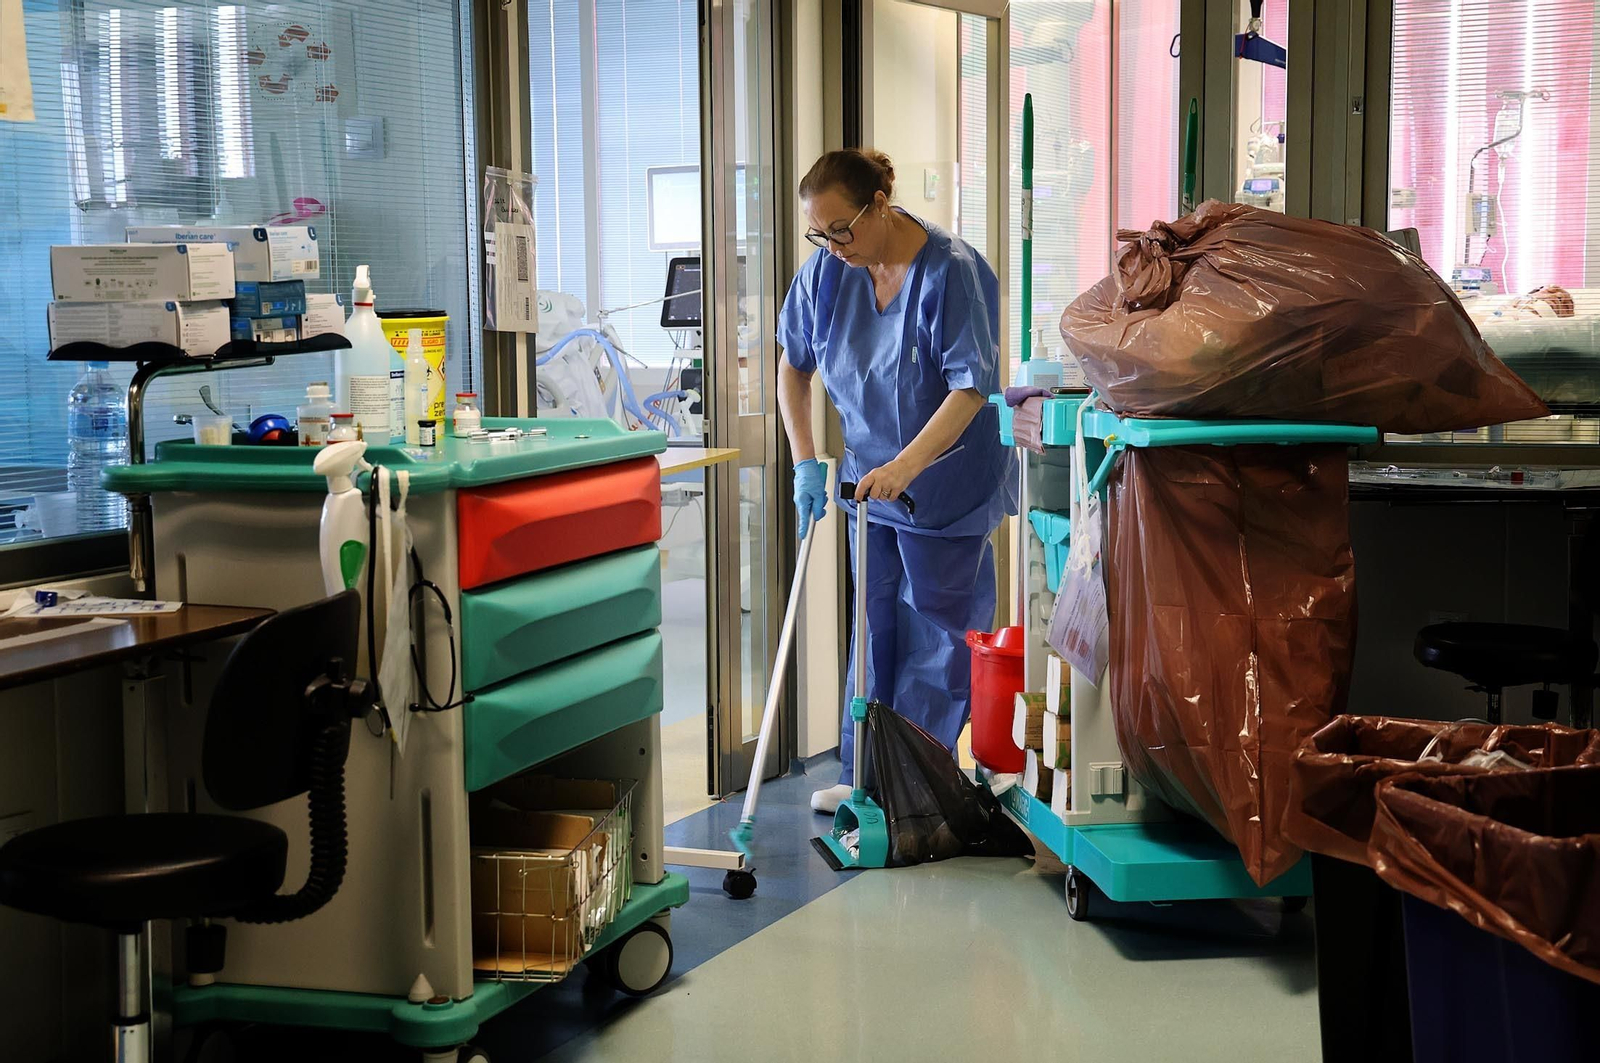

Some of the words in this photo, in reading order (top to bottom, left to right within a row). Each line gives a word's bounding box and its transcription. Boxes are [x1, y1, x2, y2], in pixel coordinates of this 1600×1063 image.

[175, 231, 198, 240] Iberian
[258, 230, 263, 239] L
[310, 228, 315, 237] L
[337, 295, 342, 303] L
